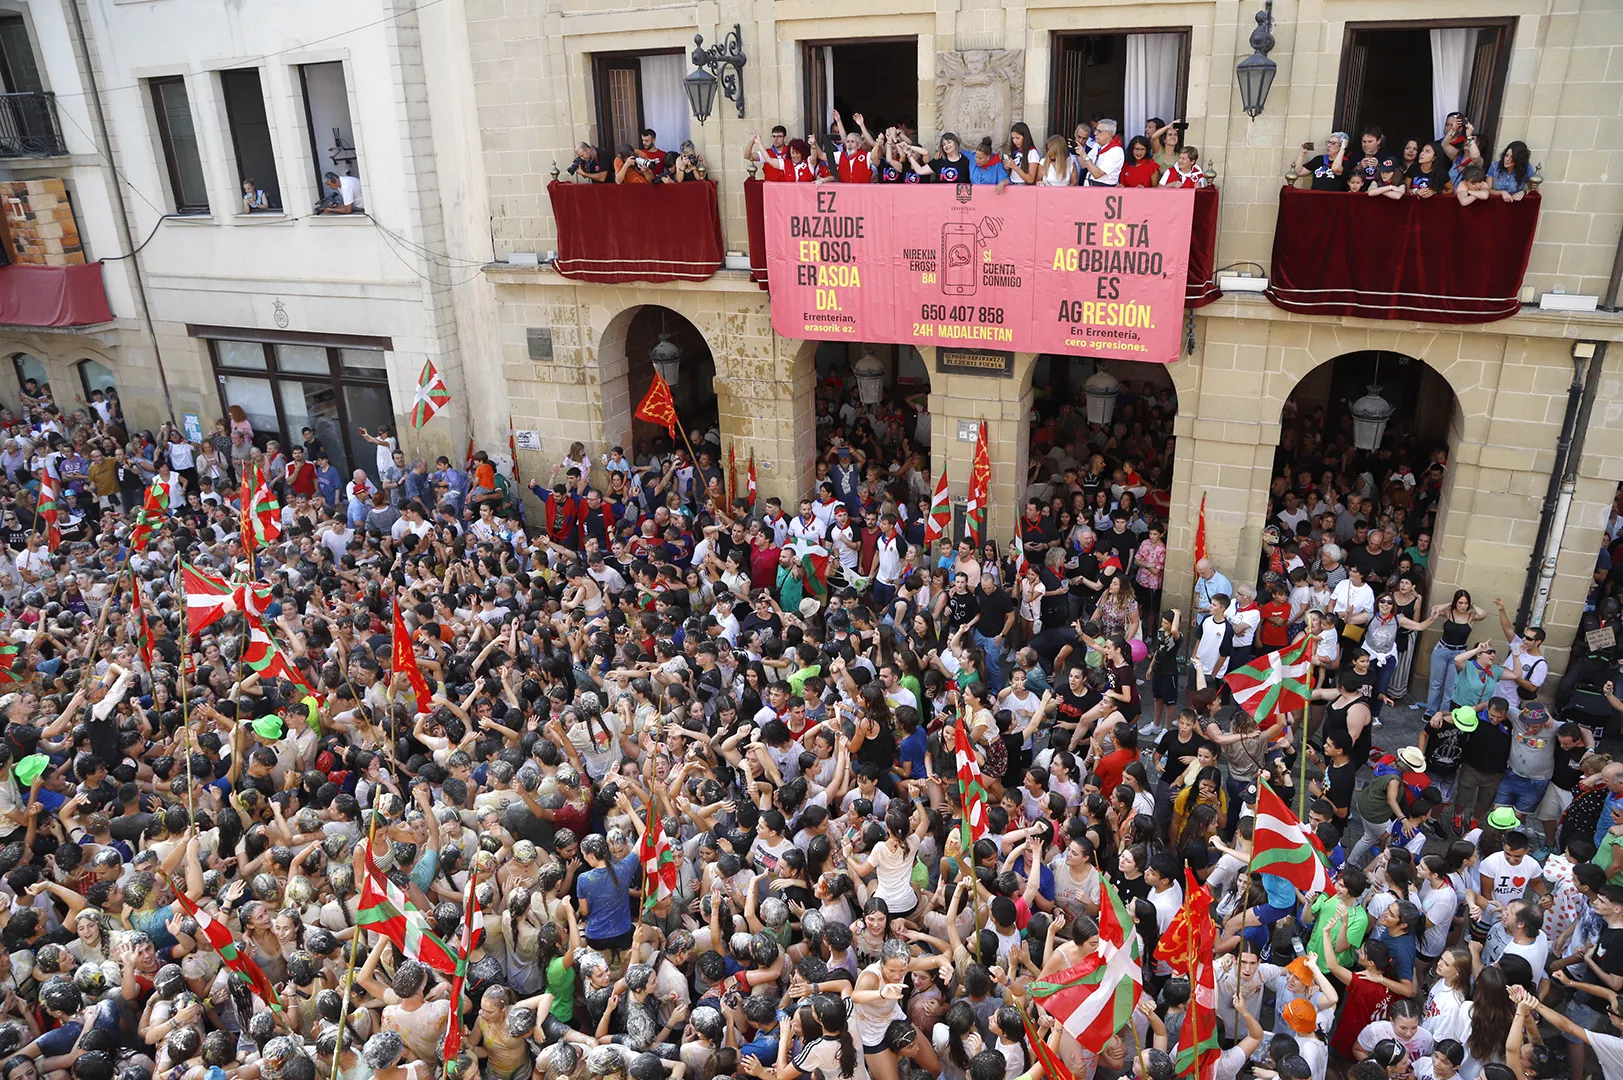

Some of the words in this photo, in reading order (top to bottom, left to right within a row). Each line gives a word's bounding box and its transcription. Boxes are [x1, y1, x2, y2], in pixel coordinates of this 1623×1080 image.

[817, 191, 837, 213] EZ
[1104, 195, 1123, 220] SI
[790, 216, 865, 239] BAZAUDE
[1074, 222, 1097, 246] TE
[1102, 219, 1150, 248] ESTÁ
[799, 240, 856, 263] EROSO,
[903, 248, 936, 260] NIREKIN
[983, 248, 992, 262] SÍ
[909, 261, 936, 272] EROSO
[982, 262, 1016, 275] CUENTA
[1052, 247, 1167, 280] AGOBIANDO,
[797, 264, 861, 288] ERASOA
[922, 273, 936, 284] BAI
[982, 275, 1022, 288] CONMIGO
[1097, 276, 1120, 300] ES
[815, 288, 842, 311] DA.
[803, 312, 856, 324] Errenterian,
[921, 304, 946, 321] 650
[949, 305, 975, 322] 407
[978, 307, 1004, 324] 858
[1057, 299, 1156, 329] AGRESIÓN.
[804, 323, 840, 332] erasorik
[842, 325, 856, 333] ez.
[912, 323, 934, 337] 24H
[938, 324, 1013, 342] MADALENETAN
[1070, 326, 1083, 336] En
[1086, 327, 1141, 341] Errenteria,
[1065, 338, 1087, 347] cero
[1089, 340, 1148, 352] agresiones.
[1498, 876, 1510, 887] I
